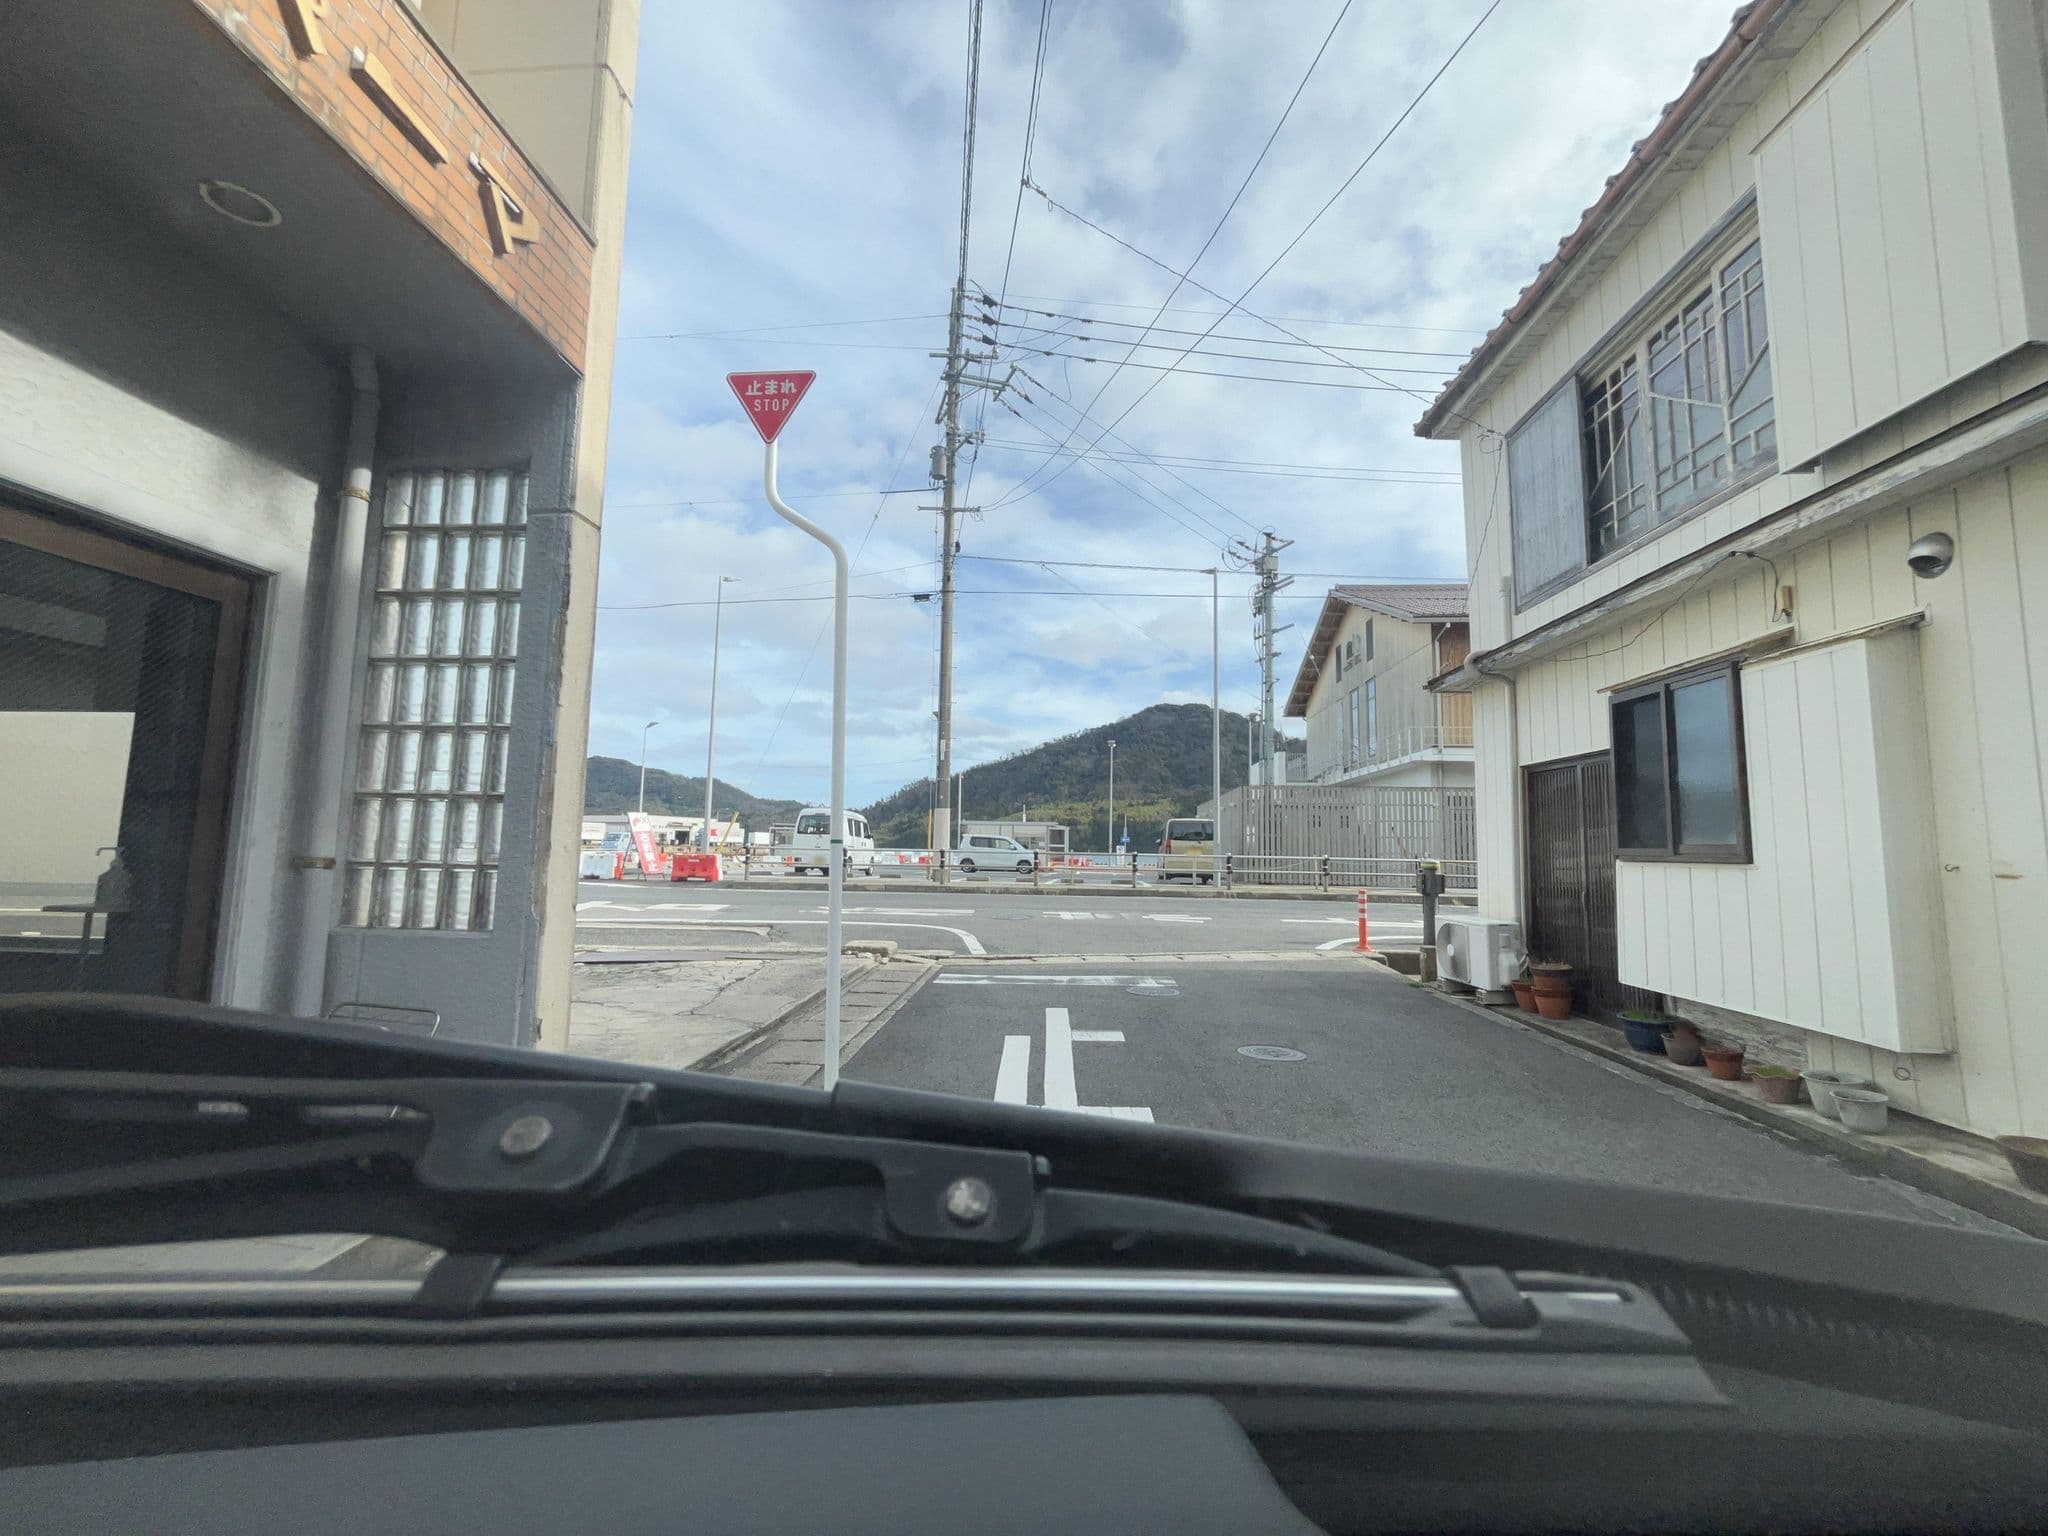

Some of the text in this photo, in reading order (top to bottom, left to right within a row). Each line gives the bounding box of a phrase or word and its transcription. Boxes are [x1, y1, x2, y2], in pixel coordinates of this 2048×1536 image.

[277, 0, 540, 257] ーマ
[745, 378, 797, 396] 止まれ
[754, 398, 790, 412] STOP
